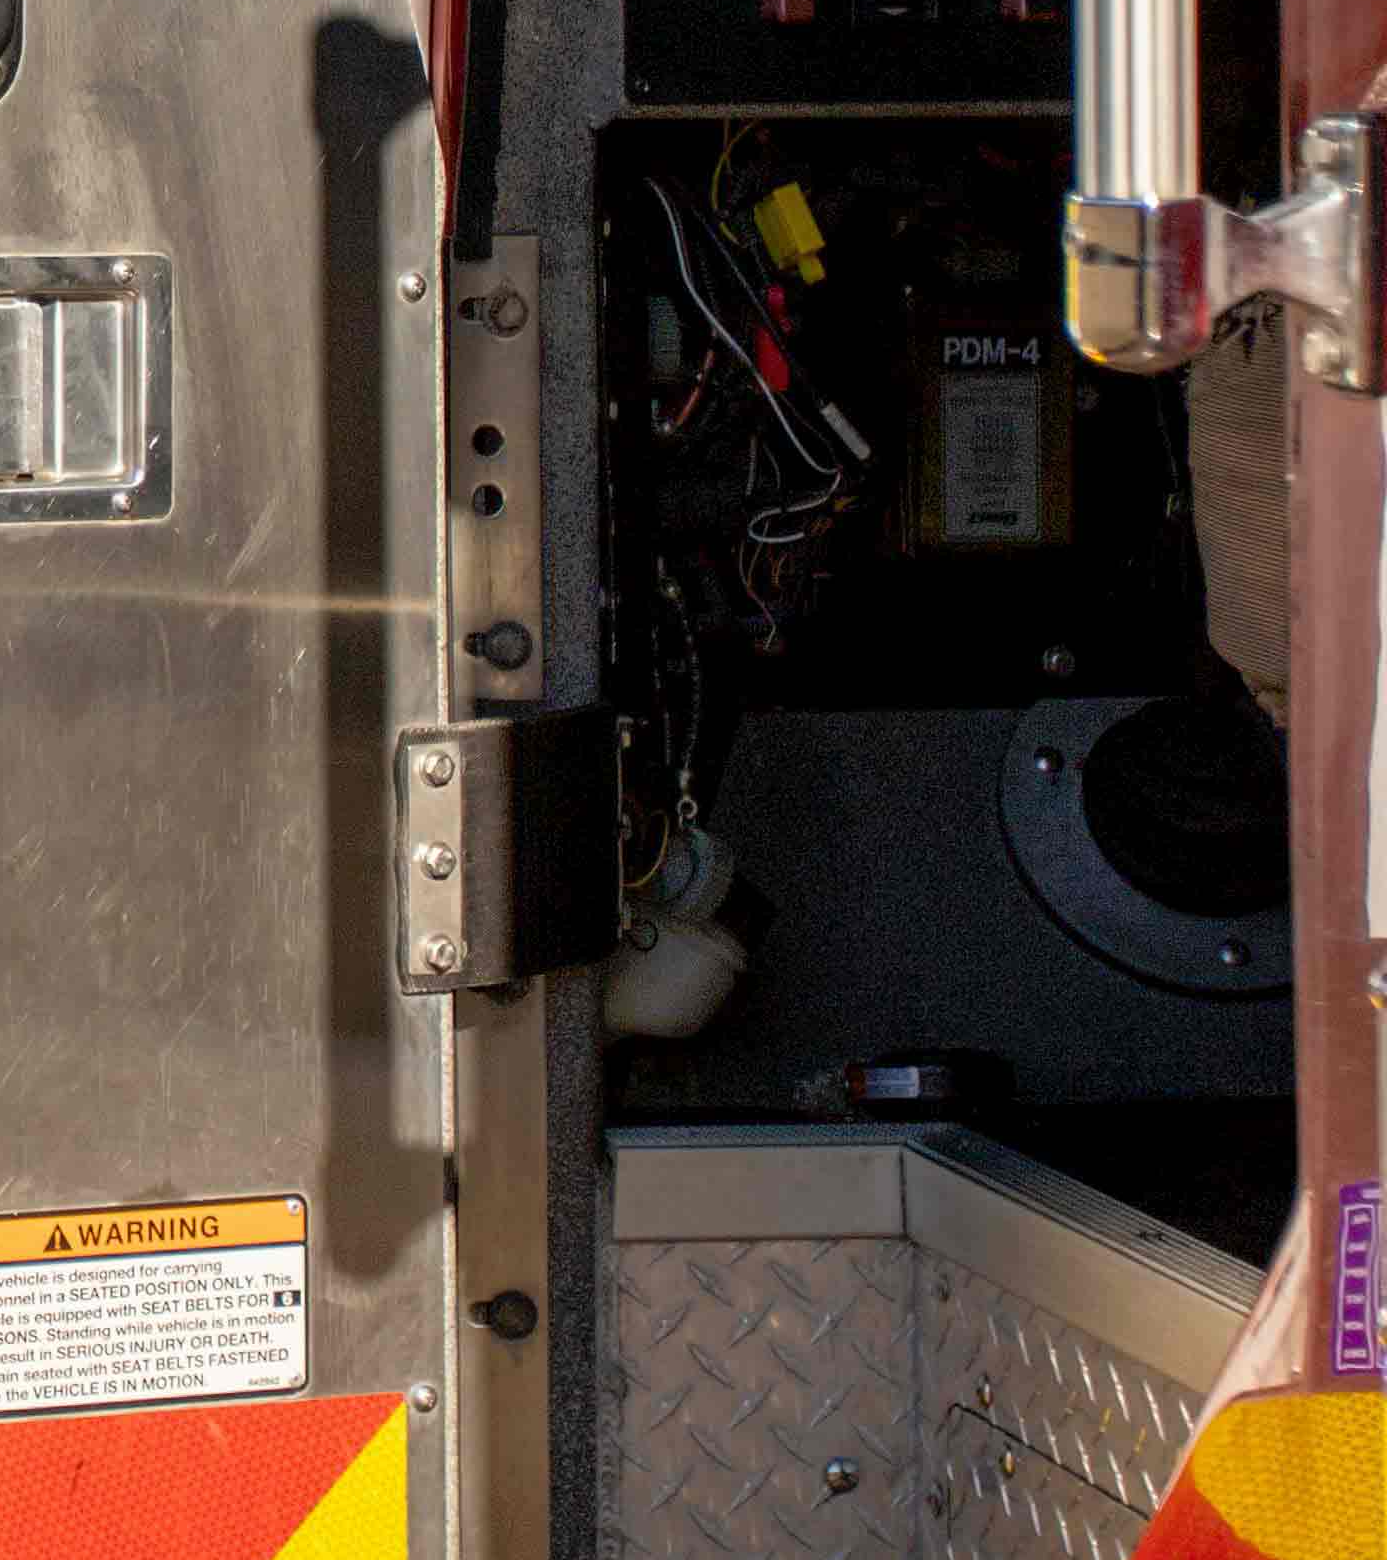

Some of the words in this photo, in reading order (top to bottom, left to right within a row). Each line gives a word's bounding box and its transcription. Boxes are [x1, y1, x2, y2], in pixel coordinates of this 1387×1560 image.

[943, 336, 1041, 366] PDM-4
[78, 1216, 218, 1246] WARNING
[52, 1272, 63, 1283] is
[69, 1267, 134, 1284] designed
[140, 1265, 157, 1277] for
[164, 1261, 221, 1276] carrying
[40, 1292, 51, 1303] in
[69, 1286, 129, 1300] SEATED
[135, 1280, 207, 1295] POSITION
[263, 1273, 291, 1286] This
[18, 1312, 29, 1323] is
[34, 1308, 101, 1324] equipped
[106, 1305, 136, 1317] with
[142, 1301, 179, 1314] SEAT
[185, 1297, 233, 1311] BELTS
[238, 1294, 268, 1307] FOR
[40, 1349, 51, 1359] in
[56, 1343, 124, 1358] SERIOUS
[130, 1339, 185, 1353] INJURY
[190, 1337, 211, 1348] OR
[218, 1332, 273, 1346] DEATH.
[24, 1367, 72, 1380] seated
[77, 1364, 106, 1376] with
[112, 1360, 148, 1373] SEAT
[156, 1356, 203, 1369] BELTS
[209, 1349, 288, 1365] FASTENED
[6, 1389, 27, 1401] the
[32, 1383, 99, 1398] VEHICLE
[104, 1382, 116, 1393] IS
[122, 1380, 136, 1391] IN
